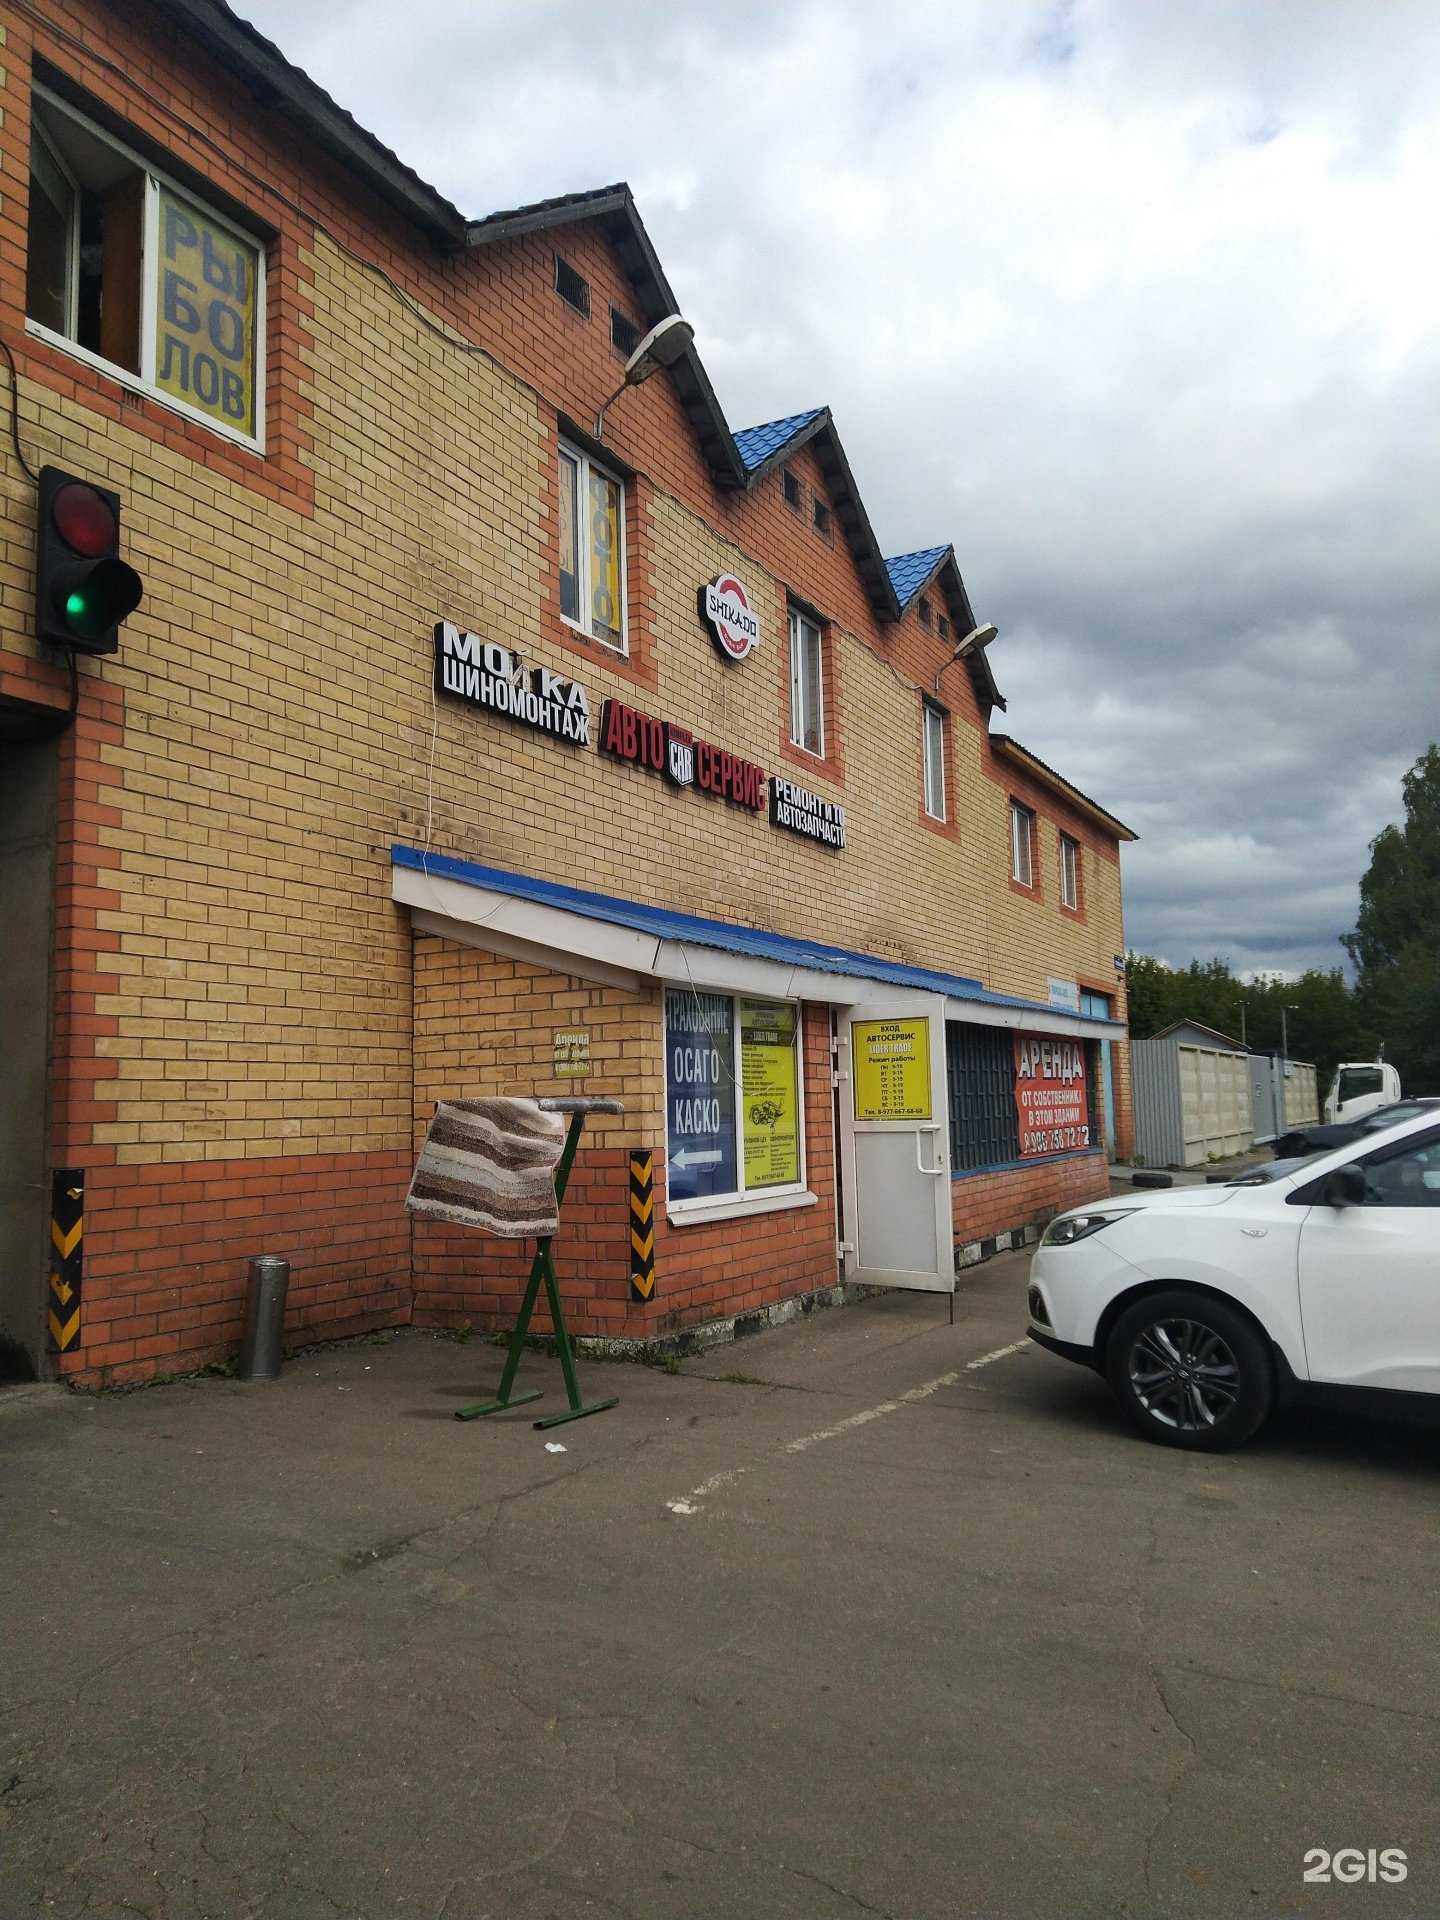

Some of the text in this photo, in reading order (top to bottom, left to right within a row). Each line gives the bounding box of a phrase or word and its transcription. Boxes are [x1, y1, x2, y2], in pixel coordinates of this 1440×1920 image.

[165, 206, 247, 304] РЫ
[164, 267, 244, 361] БО
[160, 333, 245, 420] ЛОВ
[710, 595, 757, 636] SHIKADO
[444, 656, 591, 745] ШИНОМОНТАЖ
[607, 699, 665, 770] АВТО
[670, 742, 693, 783] CAR
[697, 742, 767, 811] СЕРВИС
[776, 777, 824, 817] РЕМОНТ
[832, 804, 845, 826] ТО
[777, 800, 848, 848] АВТОЗАПЧАСТИ
[668, 992, 729, 1034] ТРАХОВАНИЕ
[866, 1033, 916, 1042] АВТОСЕРВИС
[674, 1047, 720, 1084] ОСАГО
[1018, 1040, 1083, 1086] АРЕНДА
[675, 1099, 720, 1134] КАСКО
[1022, 1091, 1032, 1106] ОТ
[1028, 1108, 1080, 1126] В ЭТОМ ЗДАНИИ
